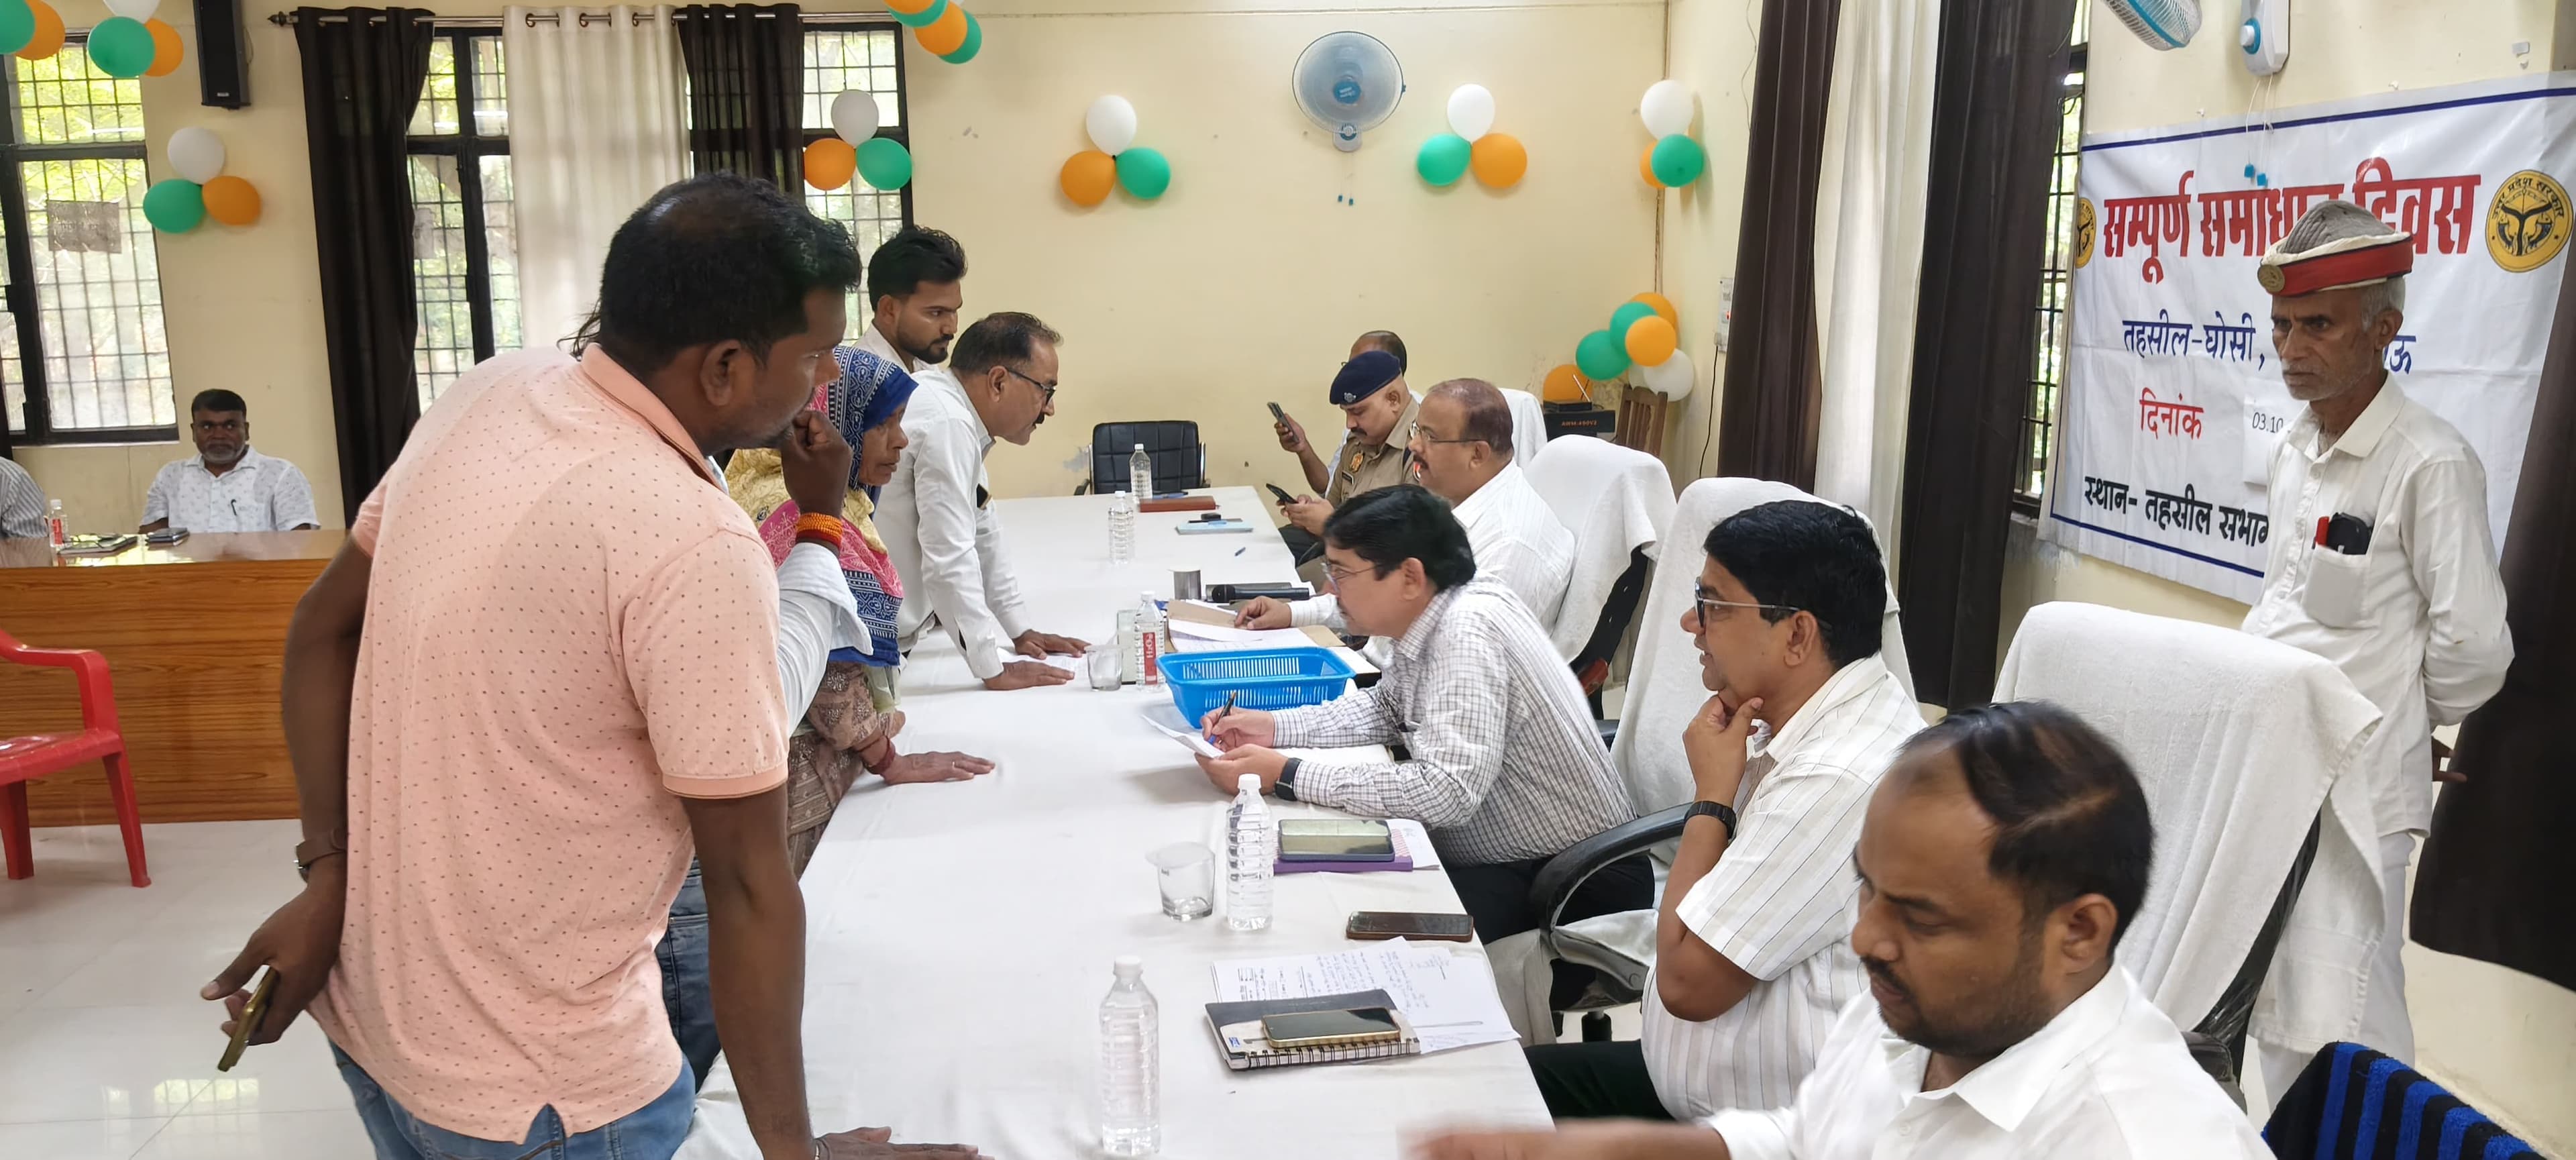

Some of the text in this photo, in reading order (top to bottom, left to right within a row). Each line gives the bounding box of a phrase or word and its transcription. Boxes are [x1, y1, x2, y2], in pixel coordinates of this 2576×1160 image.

[2104, 170, 2194, 284] सम्पूर्ण
[2198, 183, 2345, 257] समाधा
[2384, 335, 2416, 375] ऊ
[2139, 386, 2204, 440] दिनांक
[2145, 483, 2213, 535] तहसील
[2218, 505, 2269, 547] सभाग
